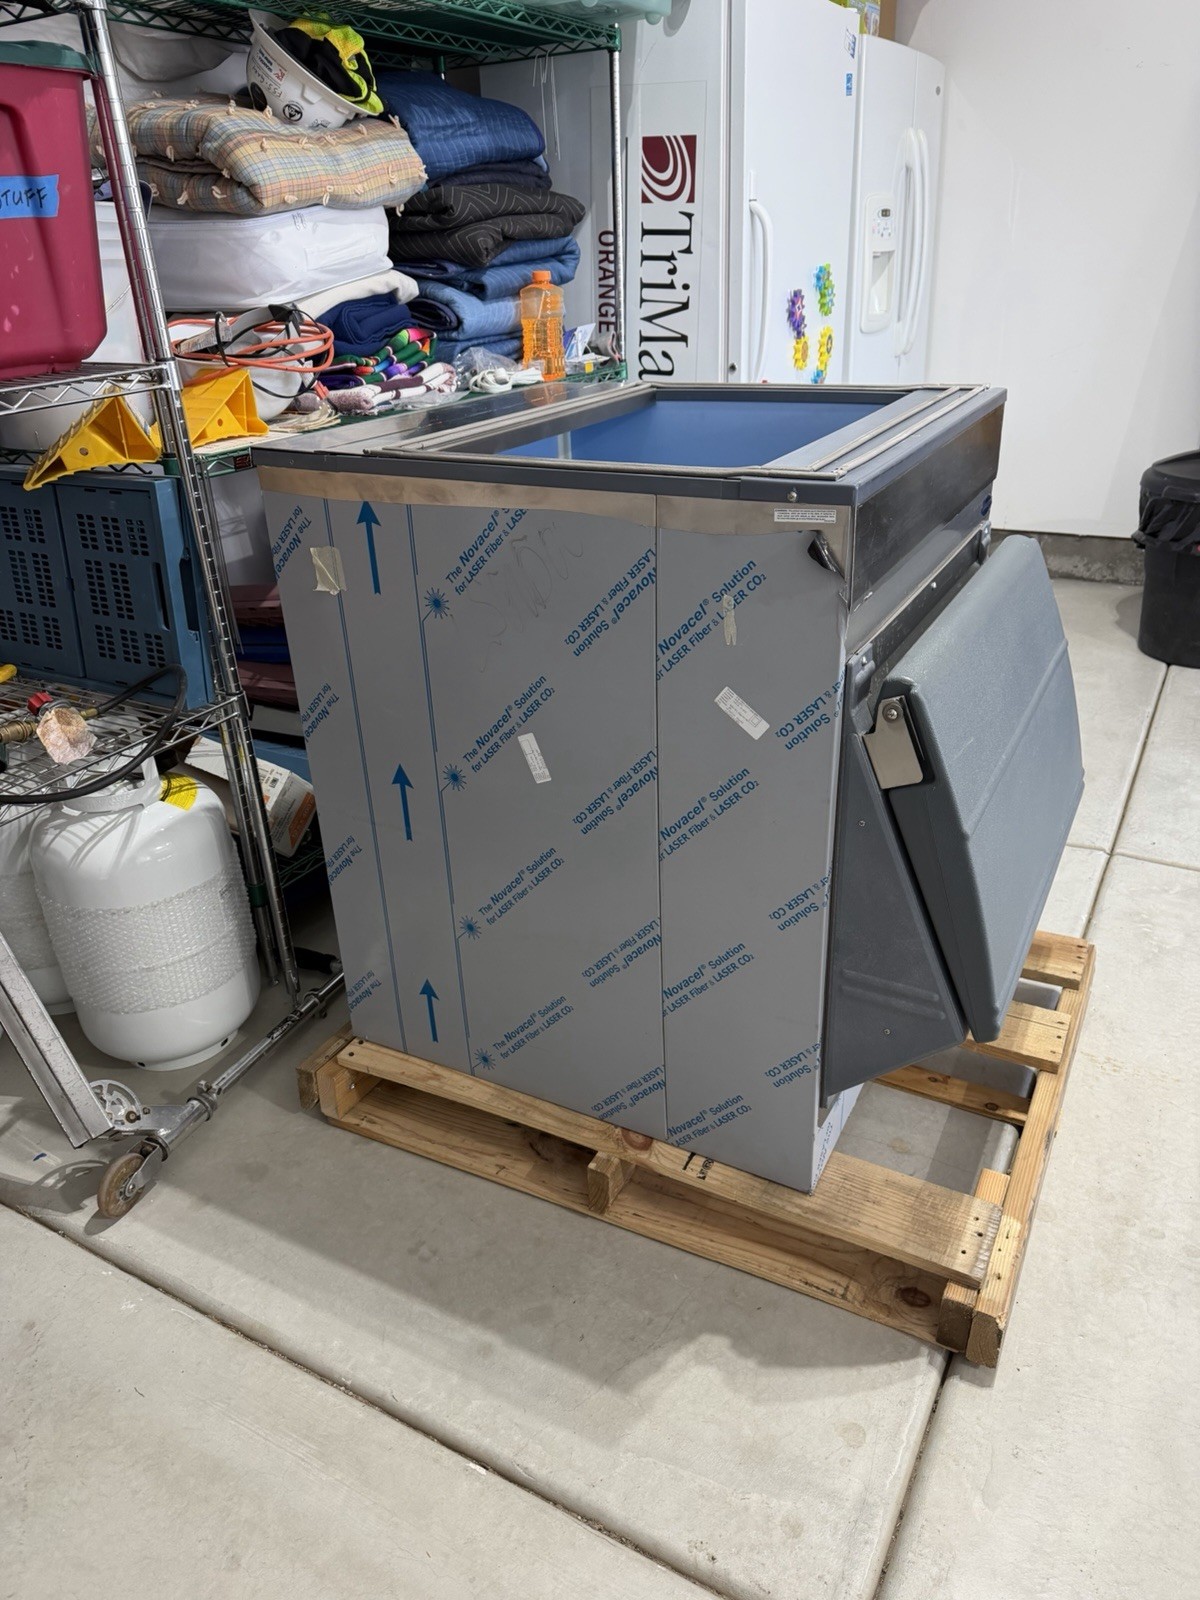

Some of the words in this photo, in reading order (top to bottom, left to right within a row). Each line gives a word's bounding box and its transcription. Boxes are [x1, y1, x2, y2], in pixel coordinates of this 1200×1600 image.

[598, 230, 616, 333] ORANGE
[638, 211, 694, 381] TriMa
[293, 505, 303, 519] for
[299, 517, 312, 533] The
[278, 517, 296, 544] LASER
[446, 566, 462, 583] The
[455, 580, 468, 595] for
[464, 555, 488, 584] LASER
[485, 534, 504, 558] Fiber
[627, 548, 657, 580] LASER
[607, 576, 630, 600] Fiber
[712, 560, 757, 603] Solution
[601, 597, 609, 605] &
[578, 604, 605, 632] LASER
[573, 620, 610, 657] Solution
[662, 644, 692, 672] LASER
[689, 623, 713, 647] Fiber
[308, 692, 325, 713] LASER
[793, 697, 827, 725] LASER
[463, 748, 479, 763] The
[514, 676, 547, 709] Solution
[785, 713, 831, 750] Solution
[471, 761, 483, 773] for
[480, 742, 502, 764] LASER
[499, 725, 517, 744] Fiber
[519, 699, 543, 724] LASER
[630, 750, 657, 774] LASER
[613, 771, 633, 790] Fiber
[709, 768, 750, 801] Solution
[585, 792, 610, 814] LASER
[581, 806, 615, 835] Solution
[664, 833, 691, 856] LASER
[688, 818, 710, 836] Fiber
[714, 792, 742, 816] LASER
[478, 903, 493, 916] The
[526, 848, 556, 874] Solution
[486, 915, 497, 925] for
[495, 900, 515, 918] LASER
[512, 887, 529, 903] Fiber
[531, 866, 553, 887] LASER
[785, 888, 816, 911] LASER
[635, 920, 660, 940] LASER
[777, 902, 820, 931] Solution
[619, 936, 637, 952] Fiber
[708, 943, 746, 970] Solution
[594, 952, 616, 971] LASER
[589, 964, 621, 988] Solution
[666, 994, 691, 1013] LASER
[689, 982, 709, 998] Fiber
[712, 962, 739, 983] LASER
[493, 1040, 506, 1051] The
[537, 996, 567, 1018] Solution
[500, 1050, 510, 1060] for
[508, 1038, 527, 1054] LASER
[525, 1028, 541, 1041] Fiber
[542, 1012, 563, 1029] LASER
[641, 1066, 664, 1083] LASER
[780, 1052, 808, 1070] LASER
[773, 1065, 812, 1088] Solution
[709, 1094, 744, 1115] Solution
[672, 1134, 695, 1147] ASER
[692, 1126, 710, 1138] Fiber
[713, 1111, 738, 1127] LASER
